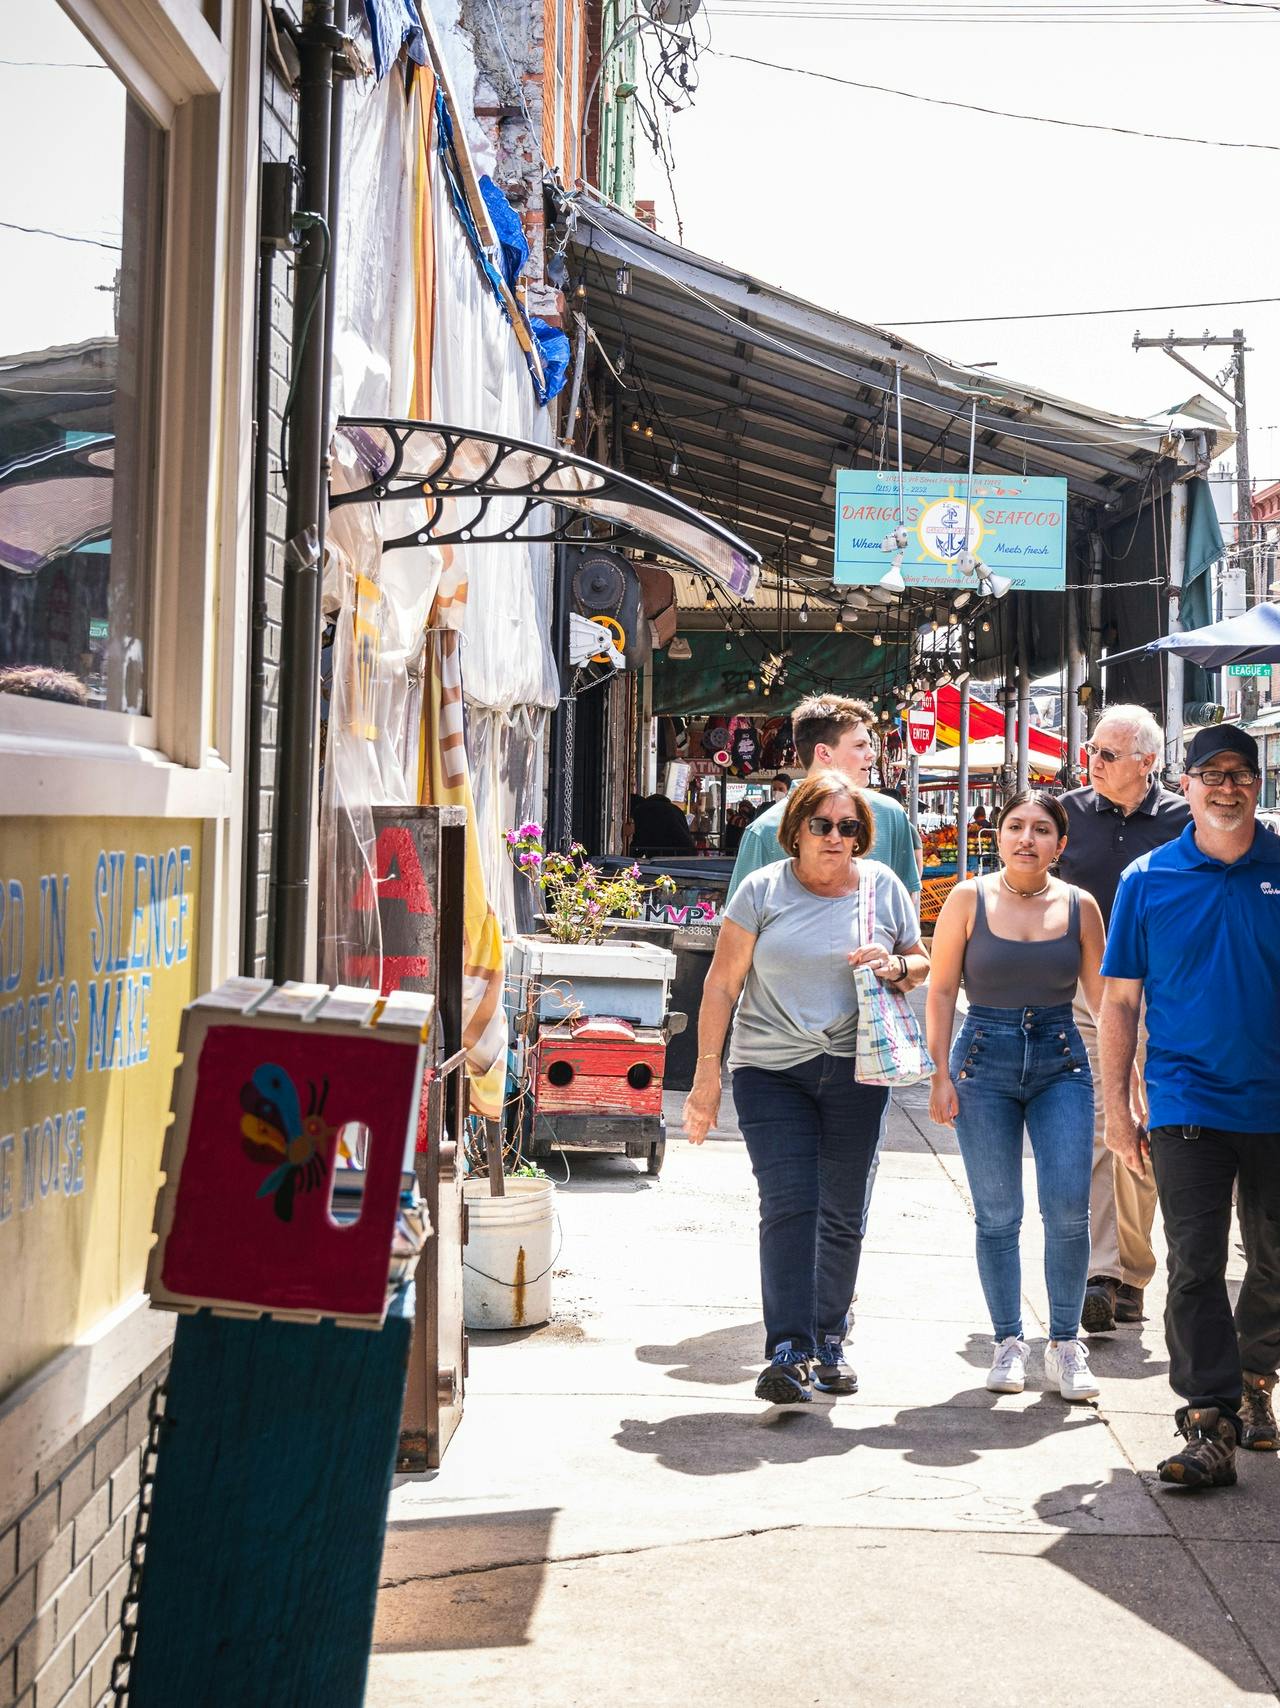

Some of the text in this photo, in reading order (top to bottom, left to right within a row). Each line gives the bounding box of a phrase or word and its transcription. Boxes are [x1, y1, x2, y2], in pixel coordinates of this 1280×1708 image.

[983, 510, 1061, 527] SEAFOOD
[994, 542, 1022, 554] Meets
[1023, 544, 1049, 556] fresh
[1231, 666, 1262, 676] LEAGUE
[912, 728, 930, 741] ENTER
[688, 760, 721, 774] ATM
[37, 873, 71, 986] IN
[88, 845, 192, 975] SILENCE
[645, 904, 705, 925] MVP
[674, 926, 712, 936] 9-3363
[86, 972, 153, 1073] MAKE
[20, 1107, 87, 1210] NOISE
